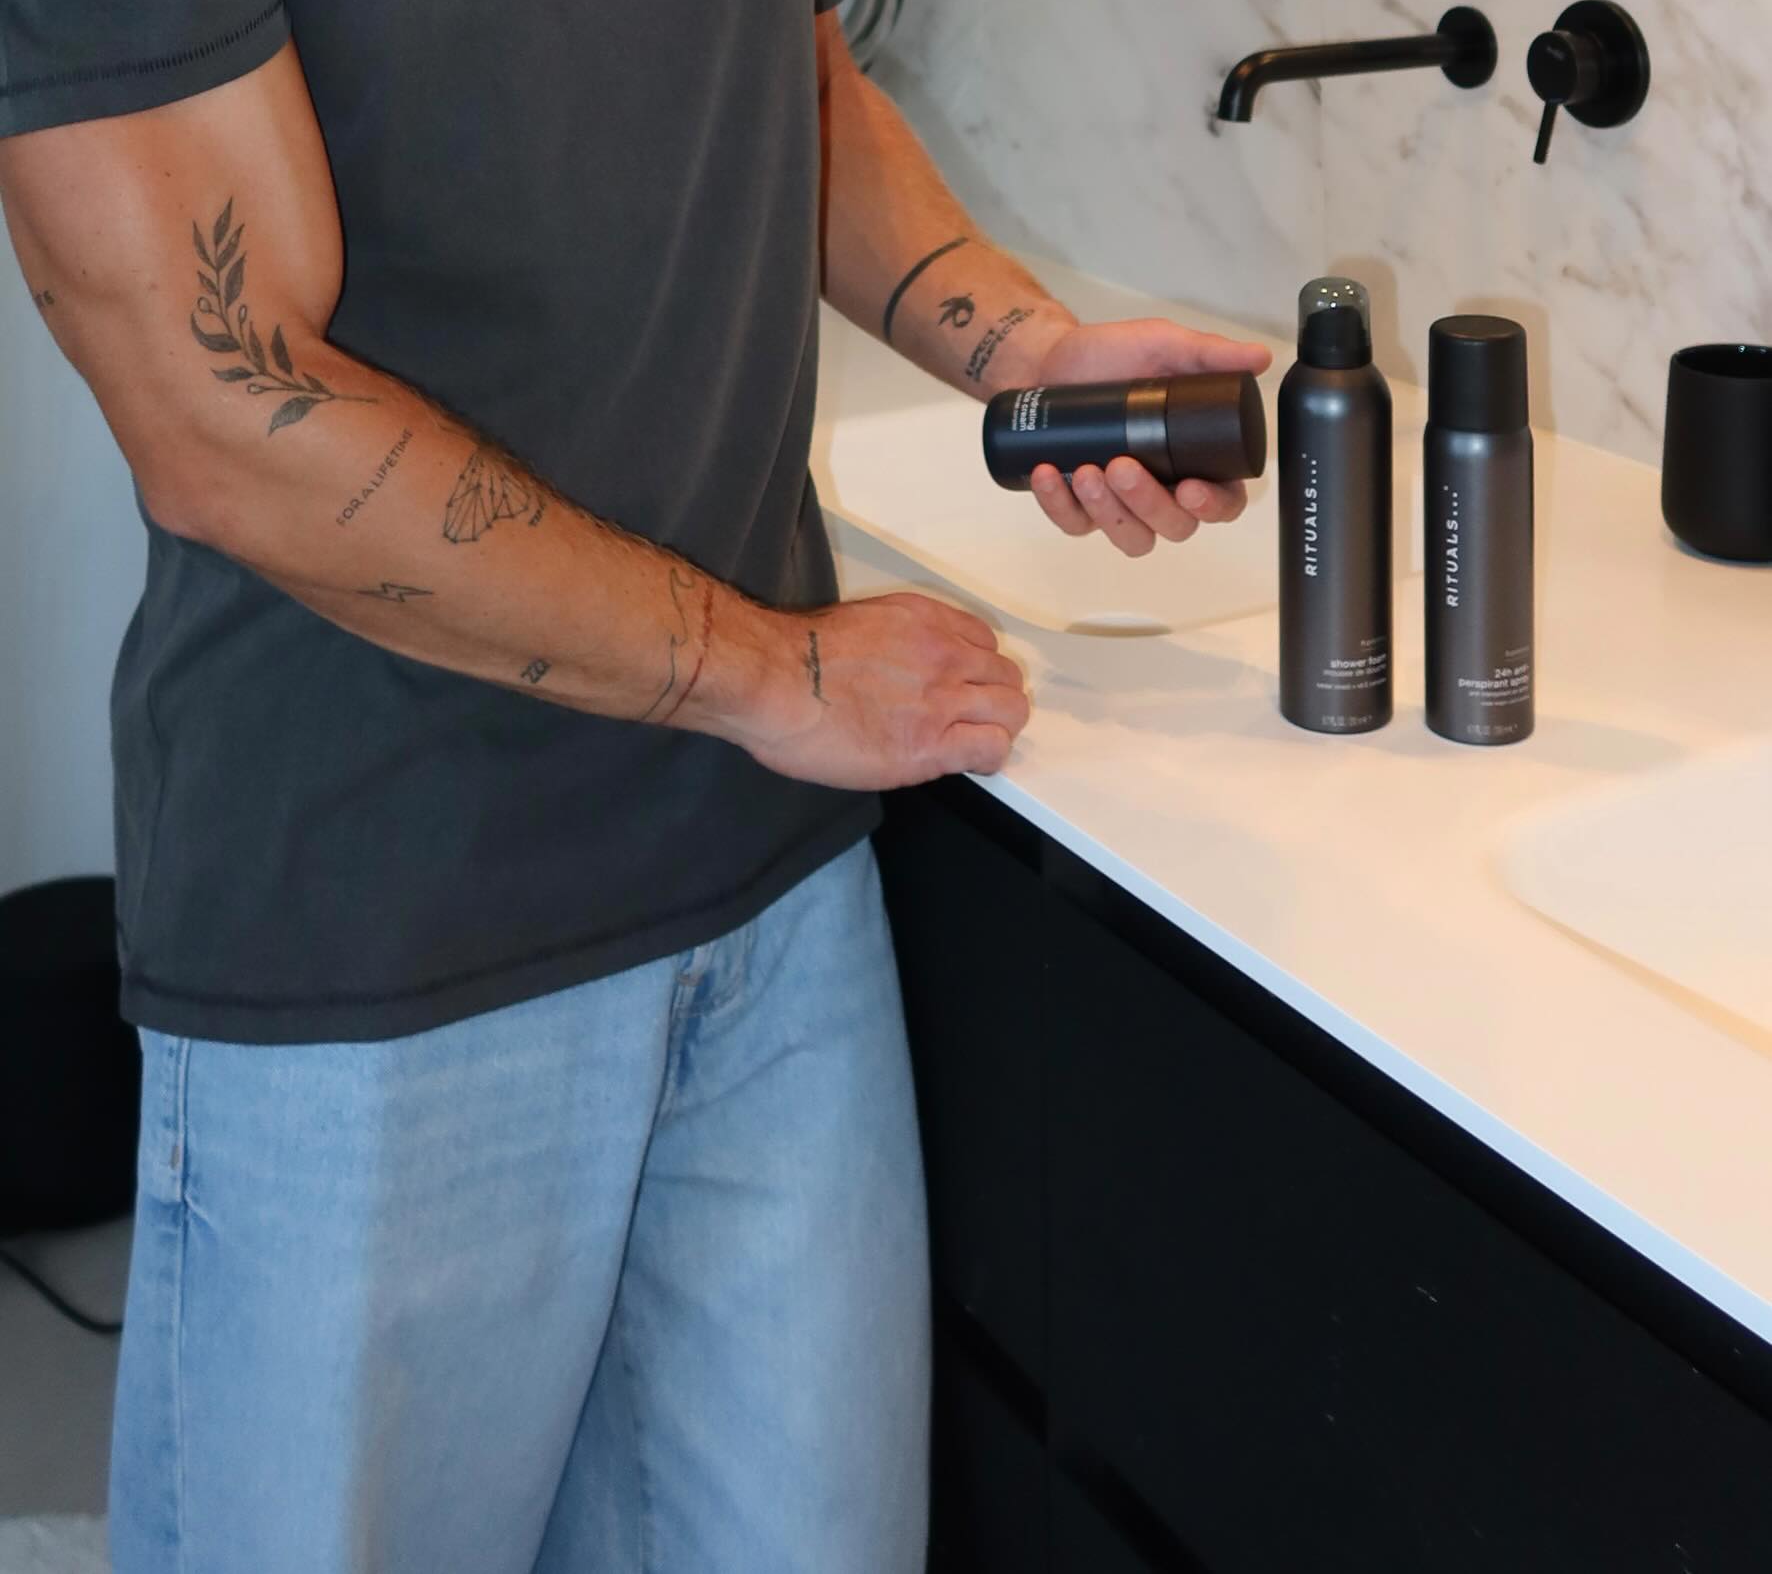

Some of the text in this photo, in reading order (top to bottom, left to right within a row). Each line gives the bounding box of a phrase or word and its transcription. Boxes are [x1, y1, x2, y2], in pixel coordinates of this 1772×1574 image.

[1019, 403, 1028, 431] cream
[336, 497, 366, 527] FOR
[1330, 659, 1366, 669] shower
[1494, 668, 1512, 679] 24h
[1458, 678, 1508, 690] perspirant
